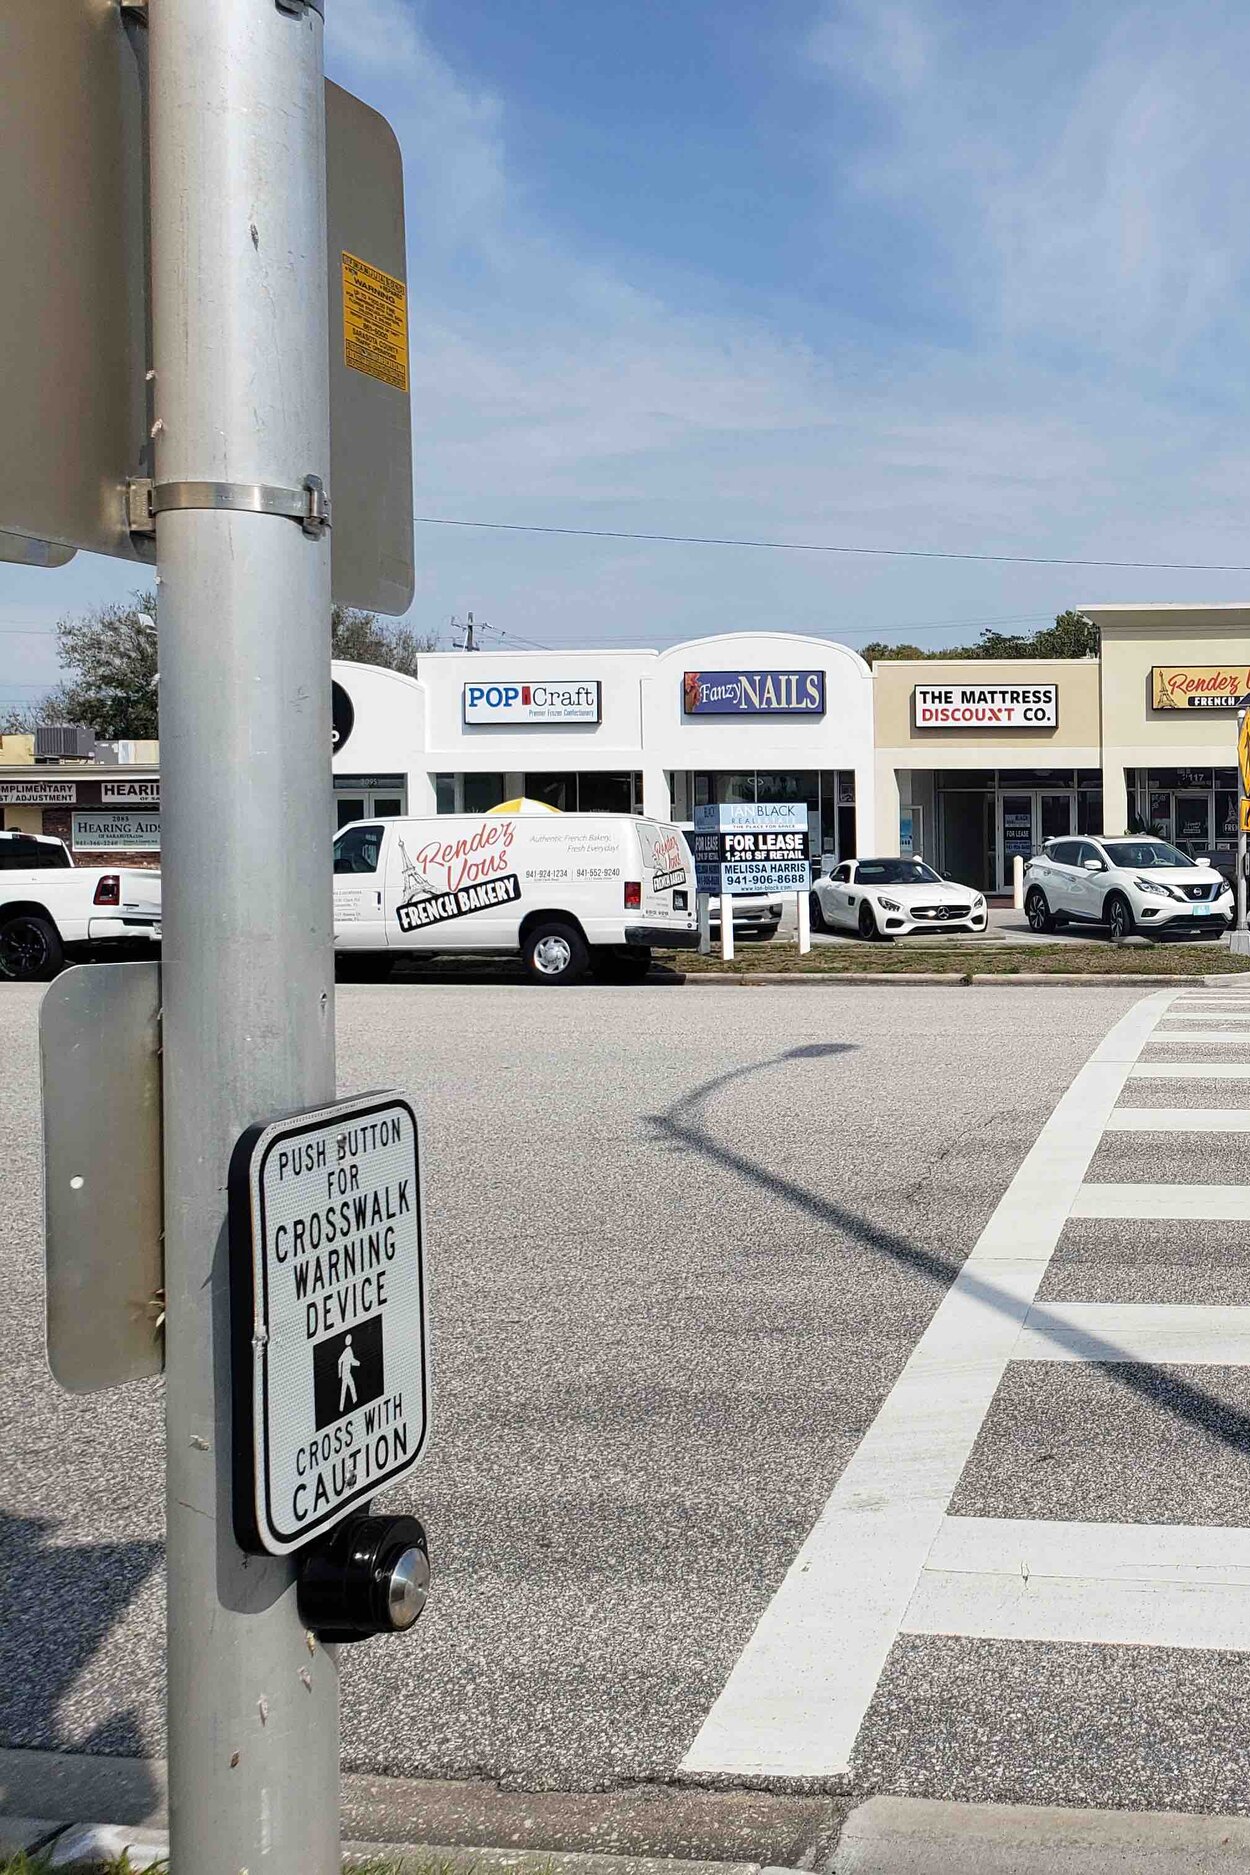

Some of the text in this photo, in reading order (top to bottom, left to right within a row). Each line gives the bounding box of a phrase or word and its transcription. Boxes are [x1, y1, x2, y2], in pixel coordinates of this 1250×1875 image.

[353, 276, 395, 304] WARNING
[351, 327, 398, 355] SARASOTA COUNTY
[700, 675, 820, 709] Fanzy NAILS
[1168, 671, 1241, 696] Rendez
[468, 687, 594, 708] POP Craft
[919, 690, 1053, 704] THE MATTRESS
[1194, 696, 1235, 706] FRENCH
[1023, 708, 1051, 721] CO.
[0, 785, 73, 793] MPLIMENTARY
[360, 778, 377, 786] 2095
[757, 805, 796, 817] BLACK
[78, 822, 131, 833] HEARING
[725, 834, 804, 850] FOR LEASE
[416, 821, 517, 893] Rendez Vous
[724, 864, 768, 875] MELISSA
[770, 863, 806, 873] HARRIS
[725, 852, 753, 862] 1,216
[754, 851, 768, 860] SF
[769, 851, 805, 860] RETAIL
[727, 874, 805, 886] 941-906-8688
[400, 895, 458, 929] FRENCH
[457, 877, 516, 912] BAKERY
[279, 1139, 327, 1181] PUSH
[327, 1163, 360, 1200] FOR
[275, 1179, 411, 1264] CROSSWALK
[293, 1225, 396, 1301] WARNING
[306, 1270, 388, 1340] DEVICE
[296, 1392, 403, 1477] CROSS WITH
[293, 1422, 407, 1522] CAUTION
